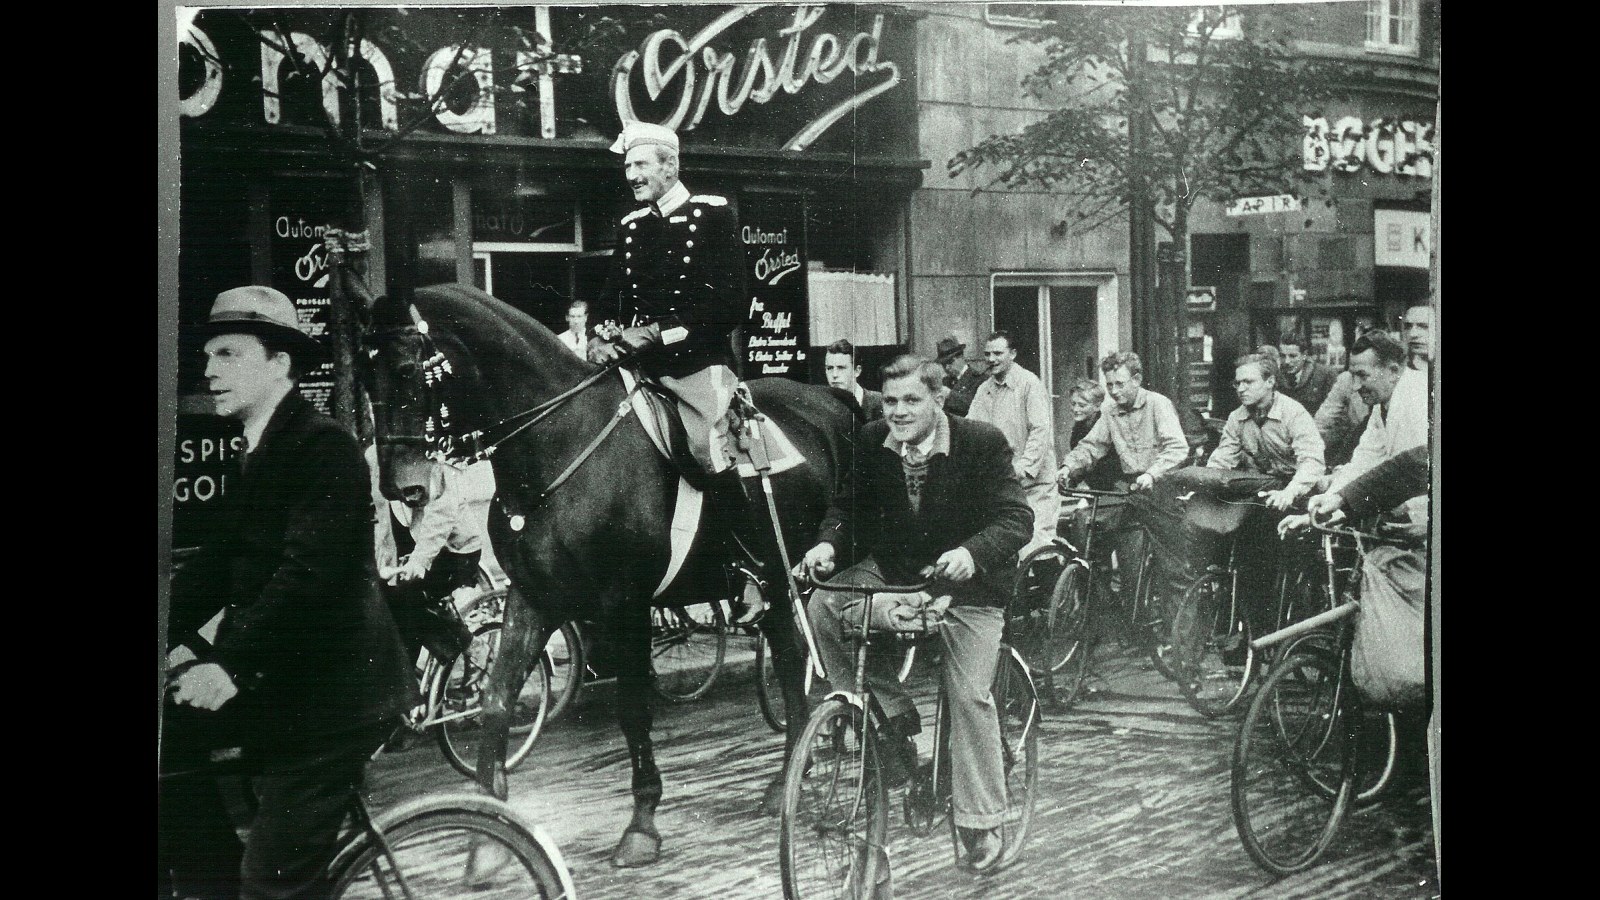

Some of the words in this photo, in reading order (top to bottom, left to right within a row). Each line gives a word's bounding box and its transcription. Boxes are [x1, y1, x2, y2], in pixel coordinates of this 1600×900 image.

[275, 216, 325, 239] Autom
[742, 225, 788, 244] Automat
[755, 247, 801, 285] Ørsted
